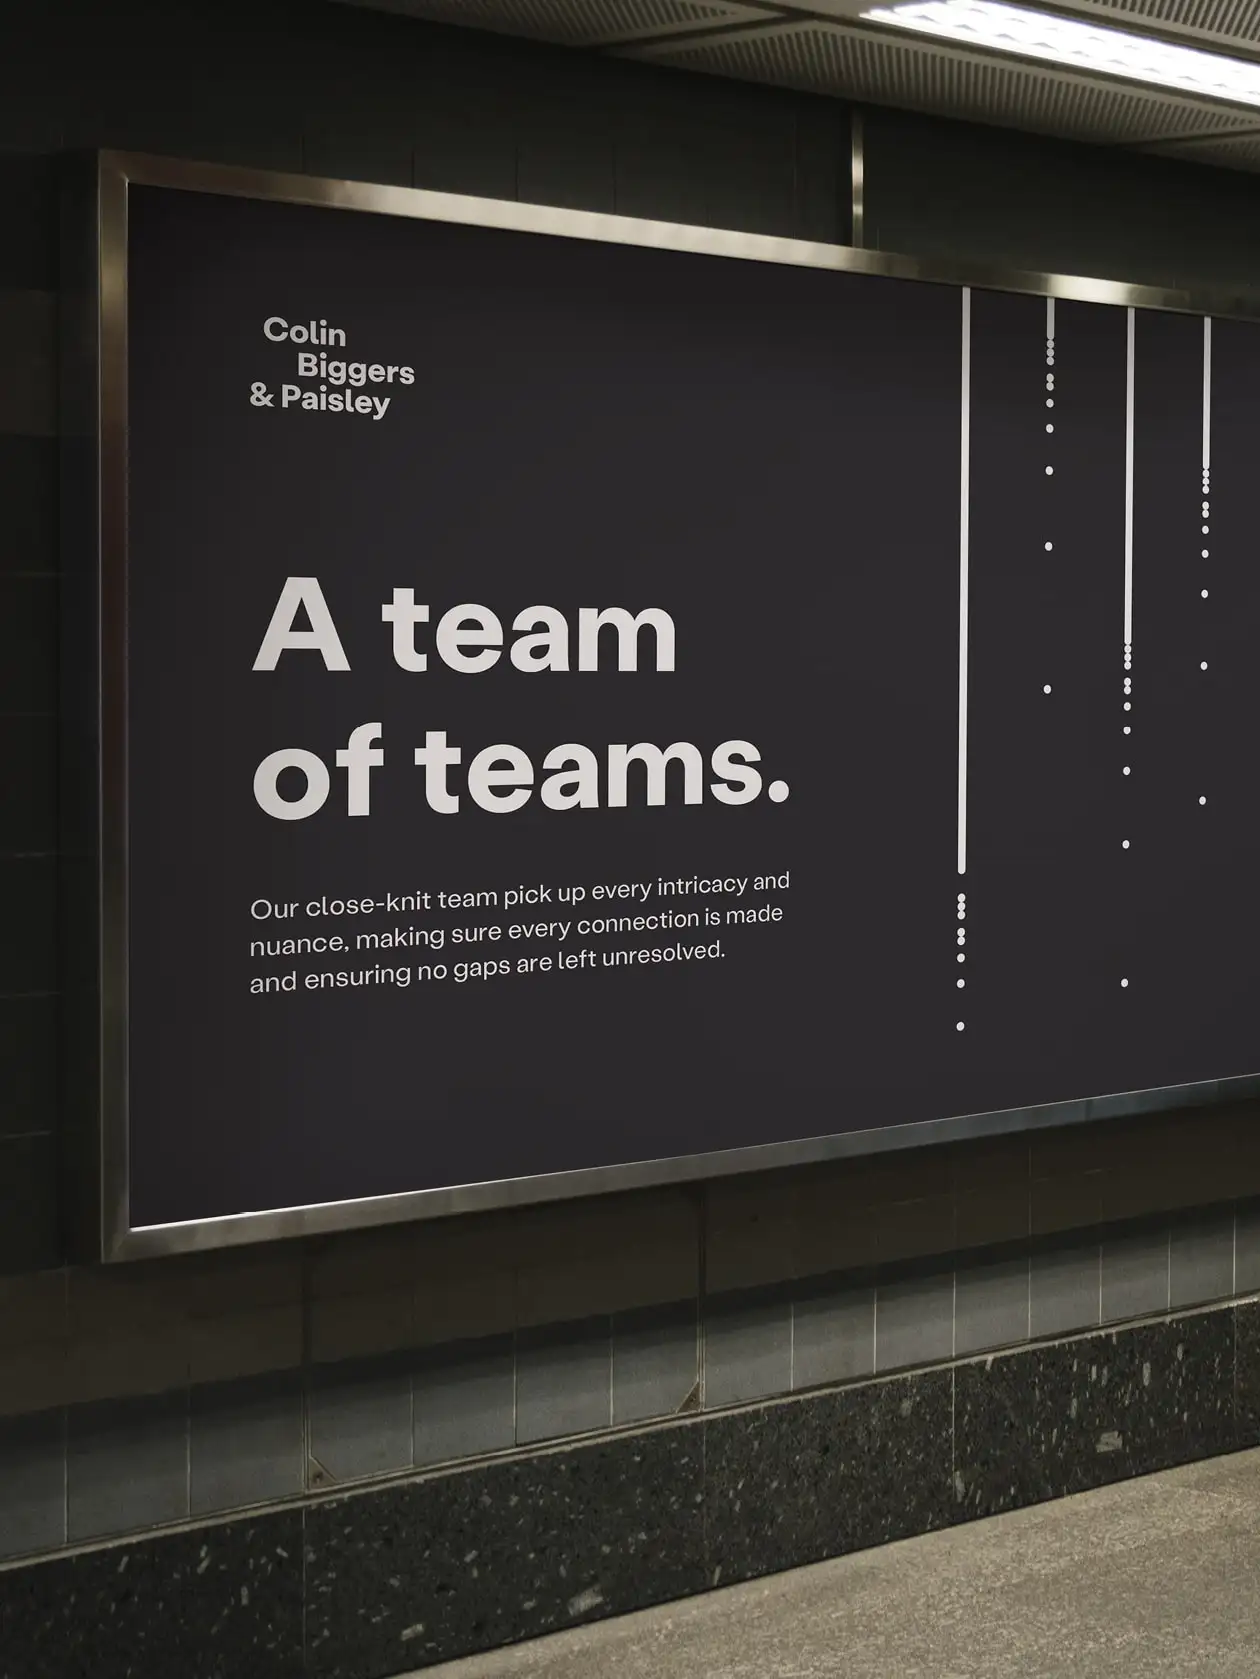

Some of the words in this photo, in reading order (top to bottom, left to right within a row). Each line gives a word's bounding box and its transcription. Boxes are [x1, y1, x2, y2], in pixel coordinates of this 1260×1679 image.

[263, 316, 346, 347] Colin
[298, 351, 415, 387] Biggers
[249, 381, 275, 408] &
[281, 383, 391, 421] Paisley
[251, 576, 352, 672] A
[381, 587, 676, 674] team
[253, 721, 385, 821] of
[414, 730, 790, 815] teams.
[250, 899, 300, 920] Our
[305, 889, 432, 917] close-knit
[437, 891, 498, 909] team
[504, 883, 553, 910] pick
[558, 886, 586, 906] up
[591, 882, 653, 903] every
[657, 875, 749, 899] intricacy
[753, 870, 790, 891] and
[250, 932, 350, 957] nuance,
[356, 925, 446, 950] making
[451, 925, 502, 944] sure
[508, 921, 572, 942] every
[577, 908, 699, 935] connection
[704, 907, 721, 926] is
[726, 903, 783, 925] made
[250, 970, 297, 994] and
[304, 963, 411, 990] ensuring
[418, 964, 448, 981] no
[453, 958, 511, 983] gaps
[516, 956, 553, 974] are
[558, 949, 597, 970] left
[602, 939, 727, 967] unresolved.
